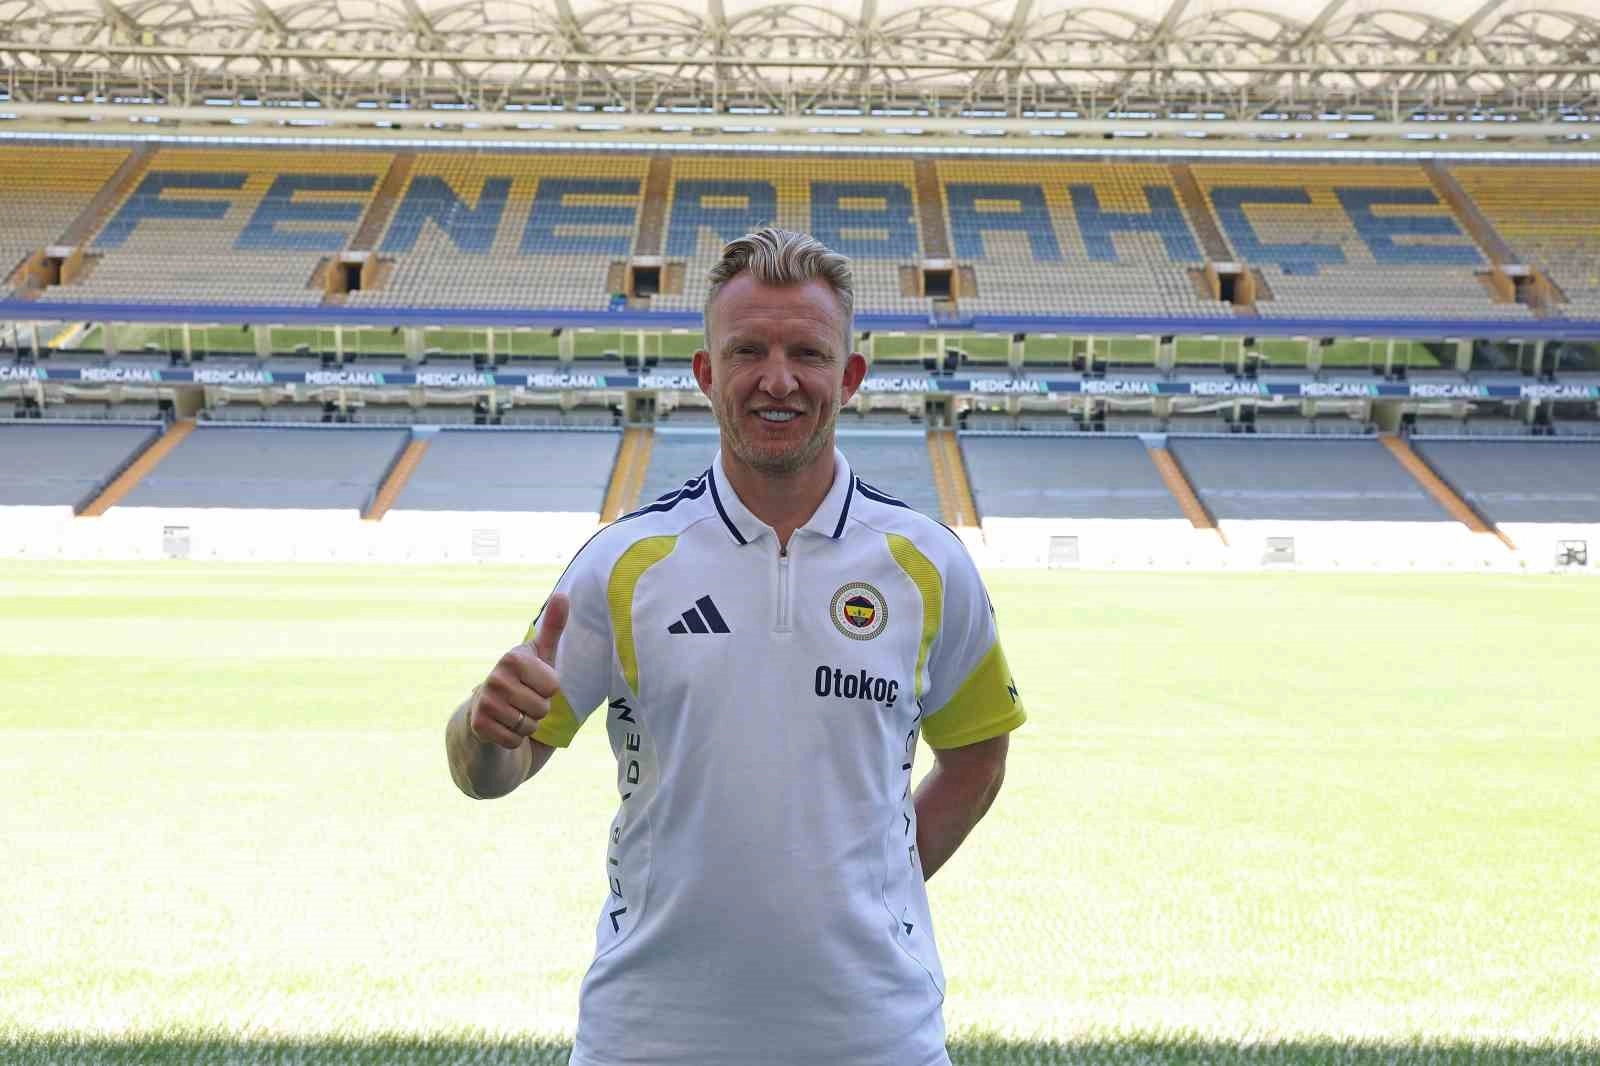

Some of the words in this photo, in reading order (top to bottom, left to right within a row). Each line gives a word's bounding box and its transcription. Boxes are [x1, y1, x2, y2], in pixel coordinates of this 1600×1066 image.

[91, 170, 1489, 276] FENERBAHÇE
[79, 367, 152, 383] MEDICANA
[193, 368, 266, 385] MEDICANA
[304, 371, 377, 385] MEDICANA
[416, 372, 488, 387] MEDICANA
[526, 374, 598, 388] MEDICANA
[638, 375, 698, 389] MEDICAN
[969, 379, 1041, 393] MEDICANA
[1080, 380, 1151, 394] MEDICANA
[1190, 381, 1261, 395] MEDICANA
[1300, 382, 1370, 397] MEDICANA
[1409, 383, 1481, 398] MEDICANA
[1520, 384, 1591, 398] MEDICANA
[814, 665, 899, 707] Otokoç
